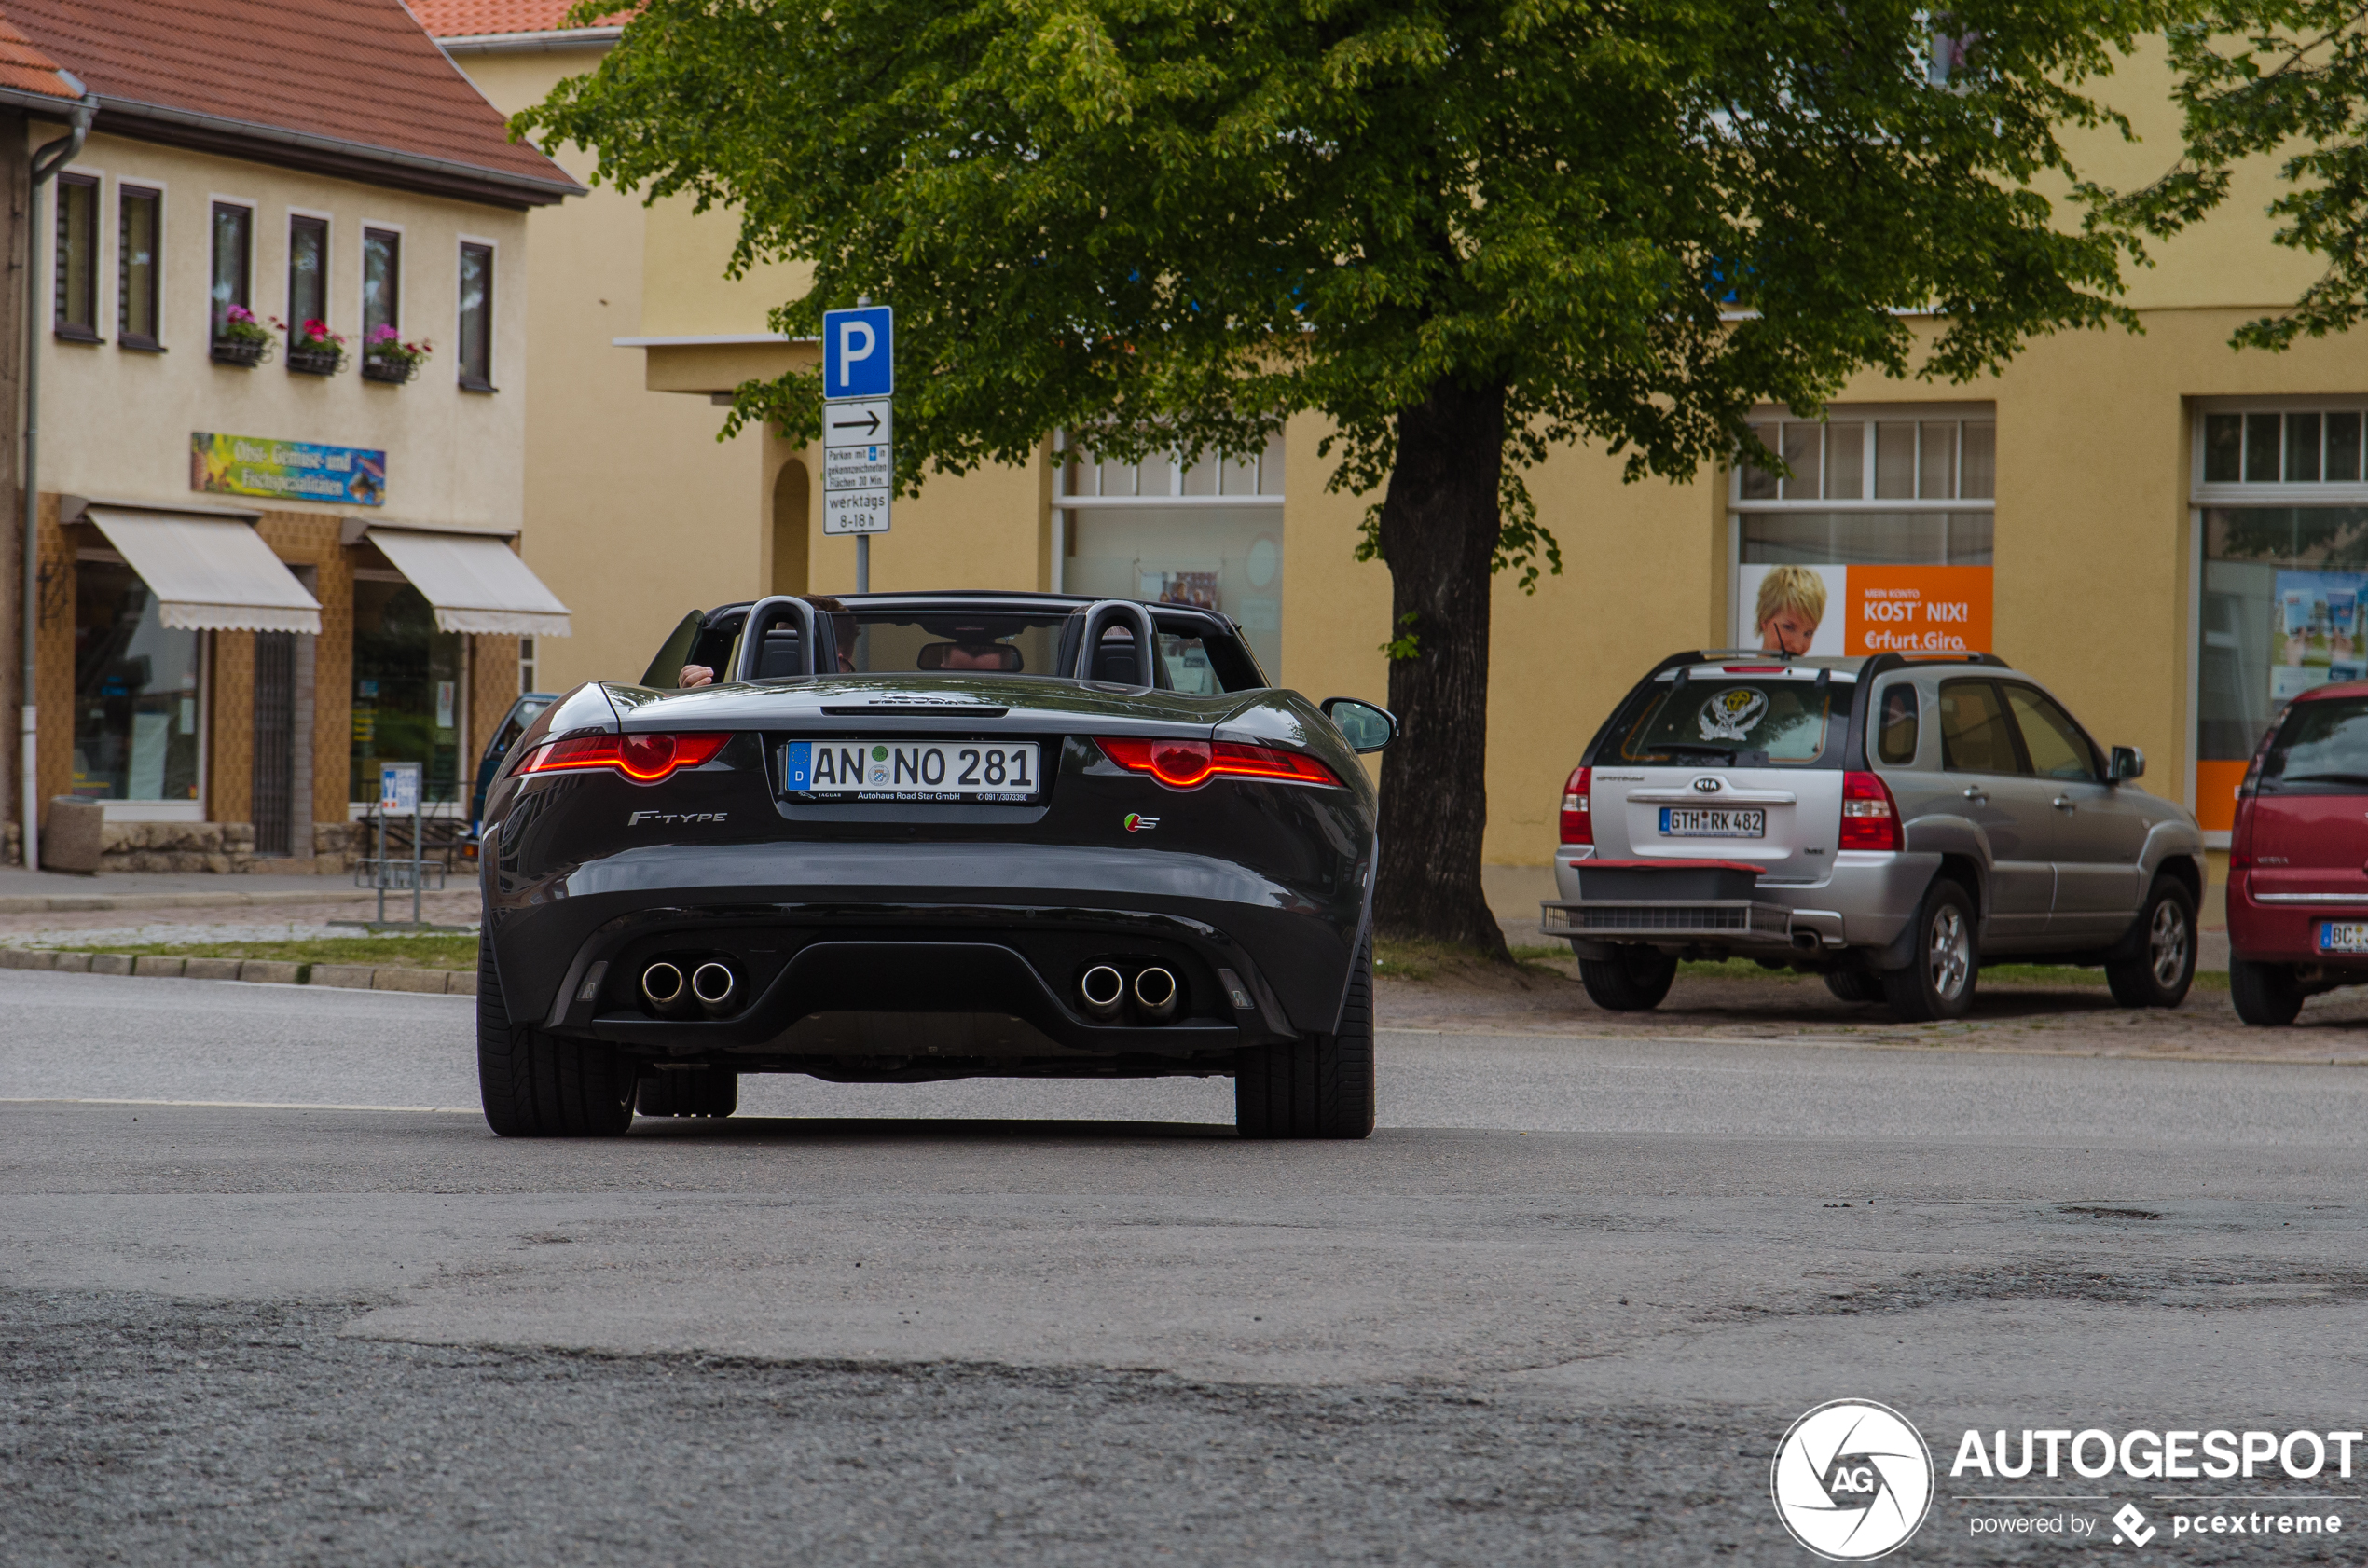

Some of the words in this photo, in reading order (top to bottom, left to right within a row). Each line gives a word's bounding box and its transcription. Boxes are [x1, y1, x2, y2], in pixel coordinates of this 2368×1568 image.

[840, 321, 875, 387] P
[828, 450, 851, 461] Parken
[855, 449, 866, 459] mit
[879, 448, 886, 457] in
[326, 452, 351, 472] und
[827, 464, 887, 477] gekennzeichneten
[829, 477, 856, 488] Flächen
[859, 476, 867, 486] 30
[870, 475, 883, 485] Min.
[829, 495, 885, 510] werktags
[840, 514, 865, 528] 8-18
[869, 514, 874, 526] h
[1865, 588, 1887, 598] MEIN
[1889, 588, 1921, 599] KONTO
[1926, 601, 1968, 622] NIX!
[812, 748, 865, 784] AN
[894, 748, 946, 785] NO
[958, 749, 1032, 786] 281
[795, 771, 804, 781] D
[1697, 780, 1717, 791] KIA
[858, 791, 894, 800] Autohaus
[896, 791, 916, 800] Road
[627, 810, 728, 826] F-TYPE
[1672, 811, 1700, 829] GTH
[1711, 812, 1729, 830] RK
[1734, 812, 1761, 830] 482
[2333, 928, 2352, 943] BC
